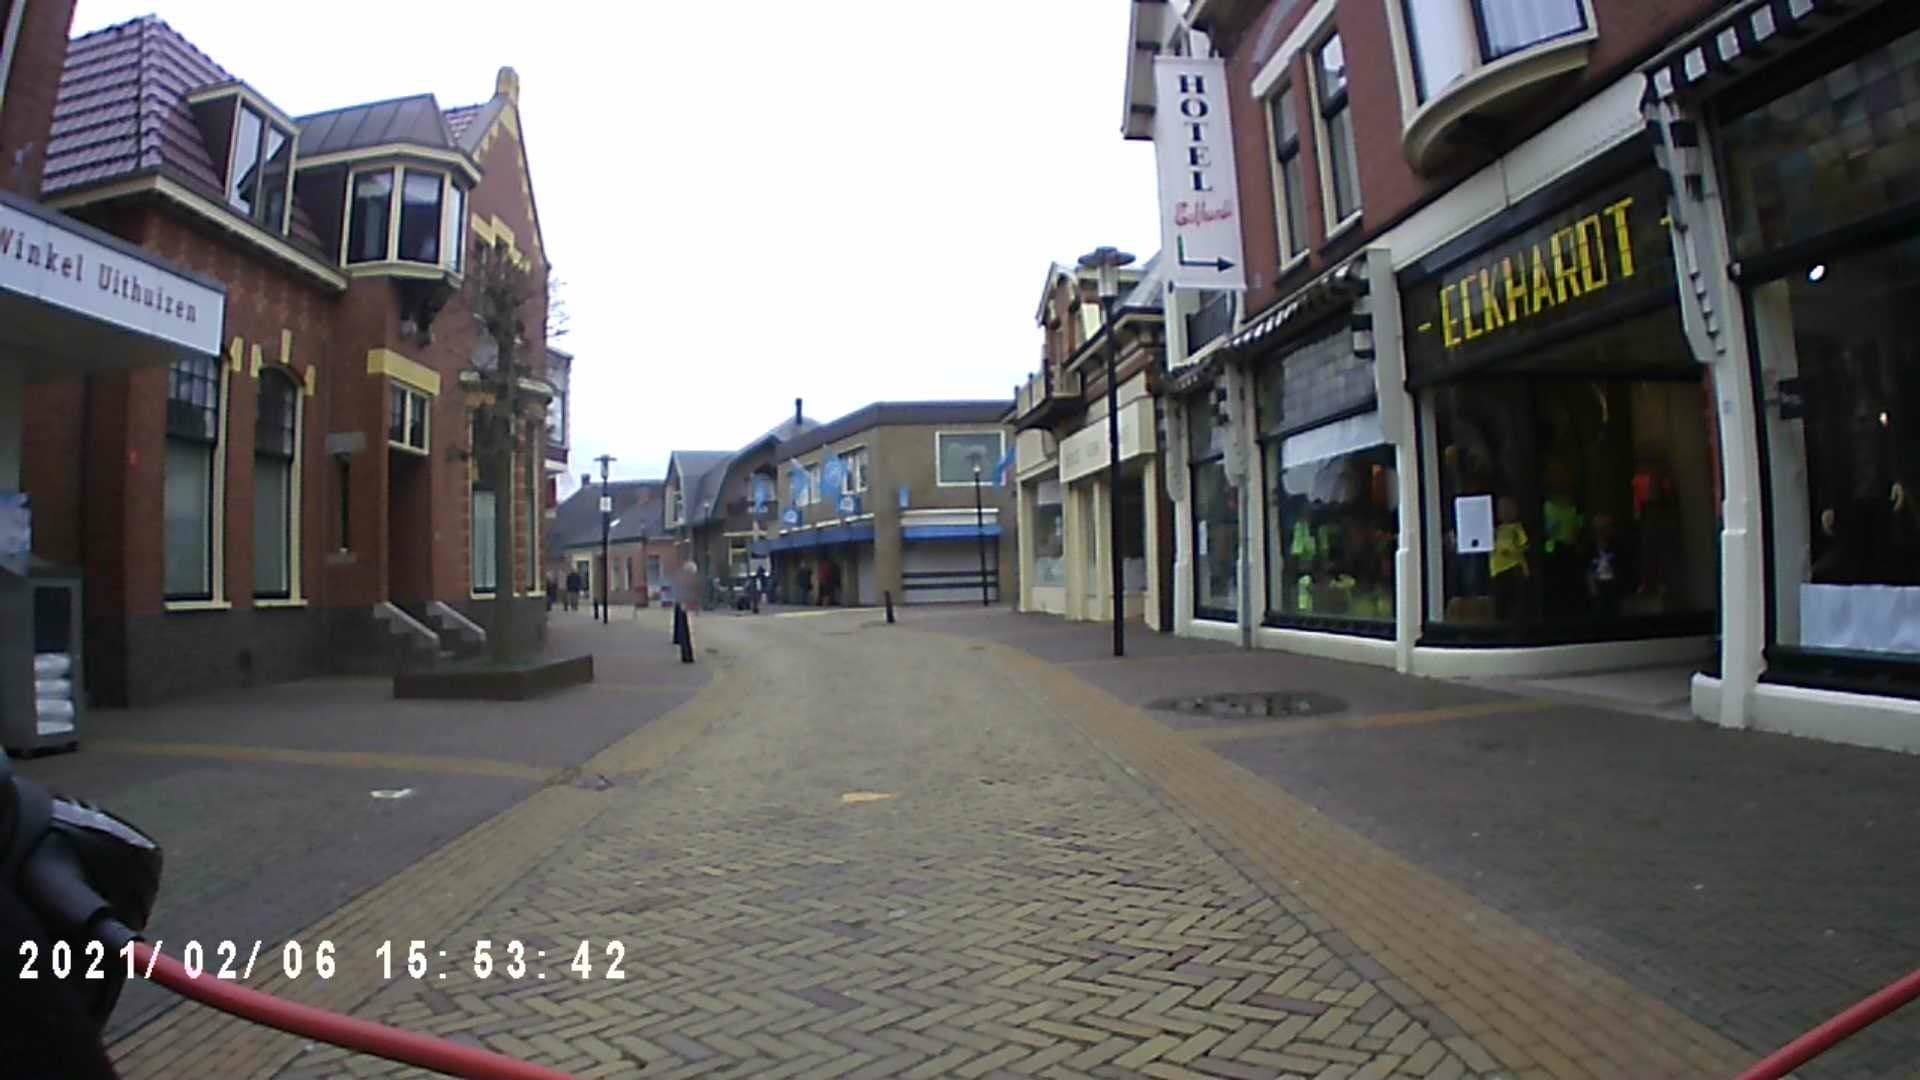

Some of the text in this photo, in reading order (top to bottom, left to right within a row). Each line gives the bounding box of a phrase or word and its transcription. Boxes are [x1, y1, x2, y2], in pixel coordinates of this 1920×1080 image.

[1178, 74, 1213, 192] HOTEL
[0, 226, 196, 323] Winkel Uithuizen
[1440, 197, 1635, 349] ECKHARDT
